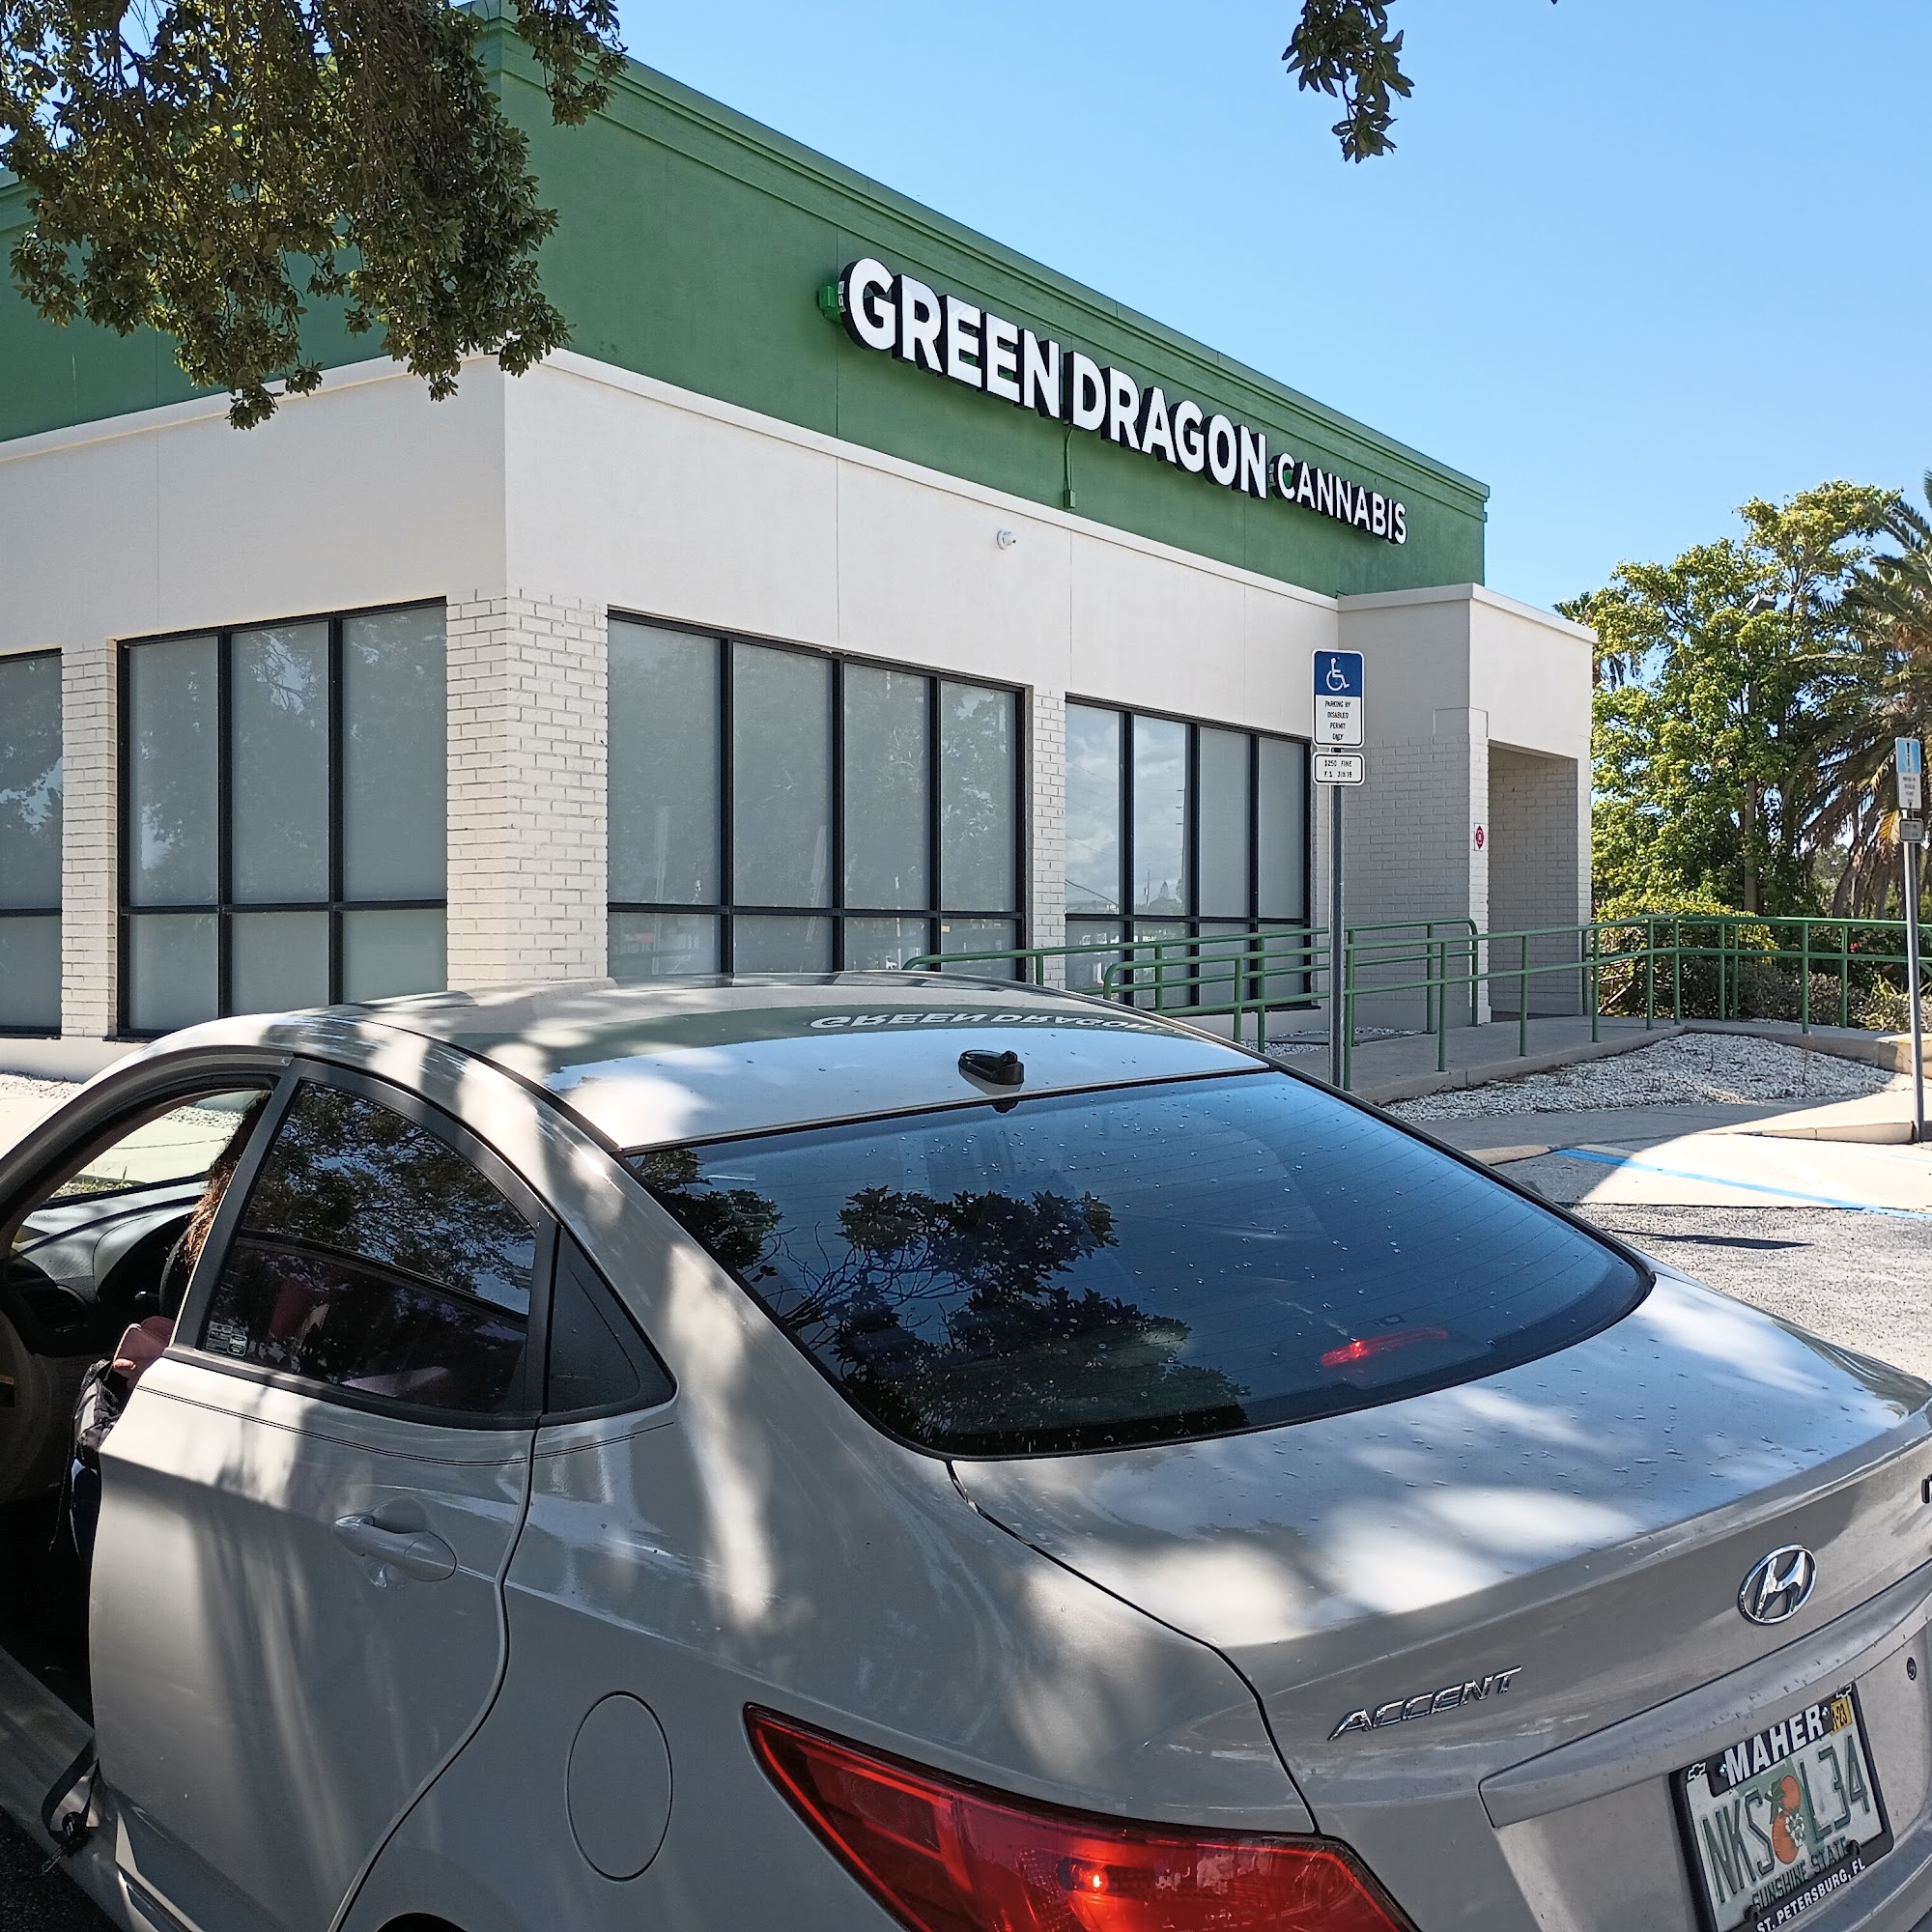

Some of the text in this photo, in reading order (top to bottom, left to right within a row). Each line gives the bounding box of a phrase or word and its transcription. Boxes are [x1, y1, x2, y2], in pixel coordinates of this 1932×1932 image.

[845, 257, 1407, 545] GREEN DRAGON CANNABIS
[1327, 1665, 1523, 1741] ACCENT
[1724, 1704, 1824, 1787] MAHER
[1751, 1835, 1848, 1912] SUNSHINE STATE
[1756, 1857, 1865, 1932] ST. PETERSBURG, FL
